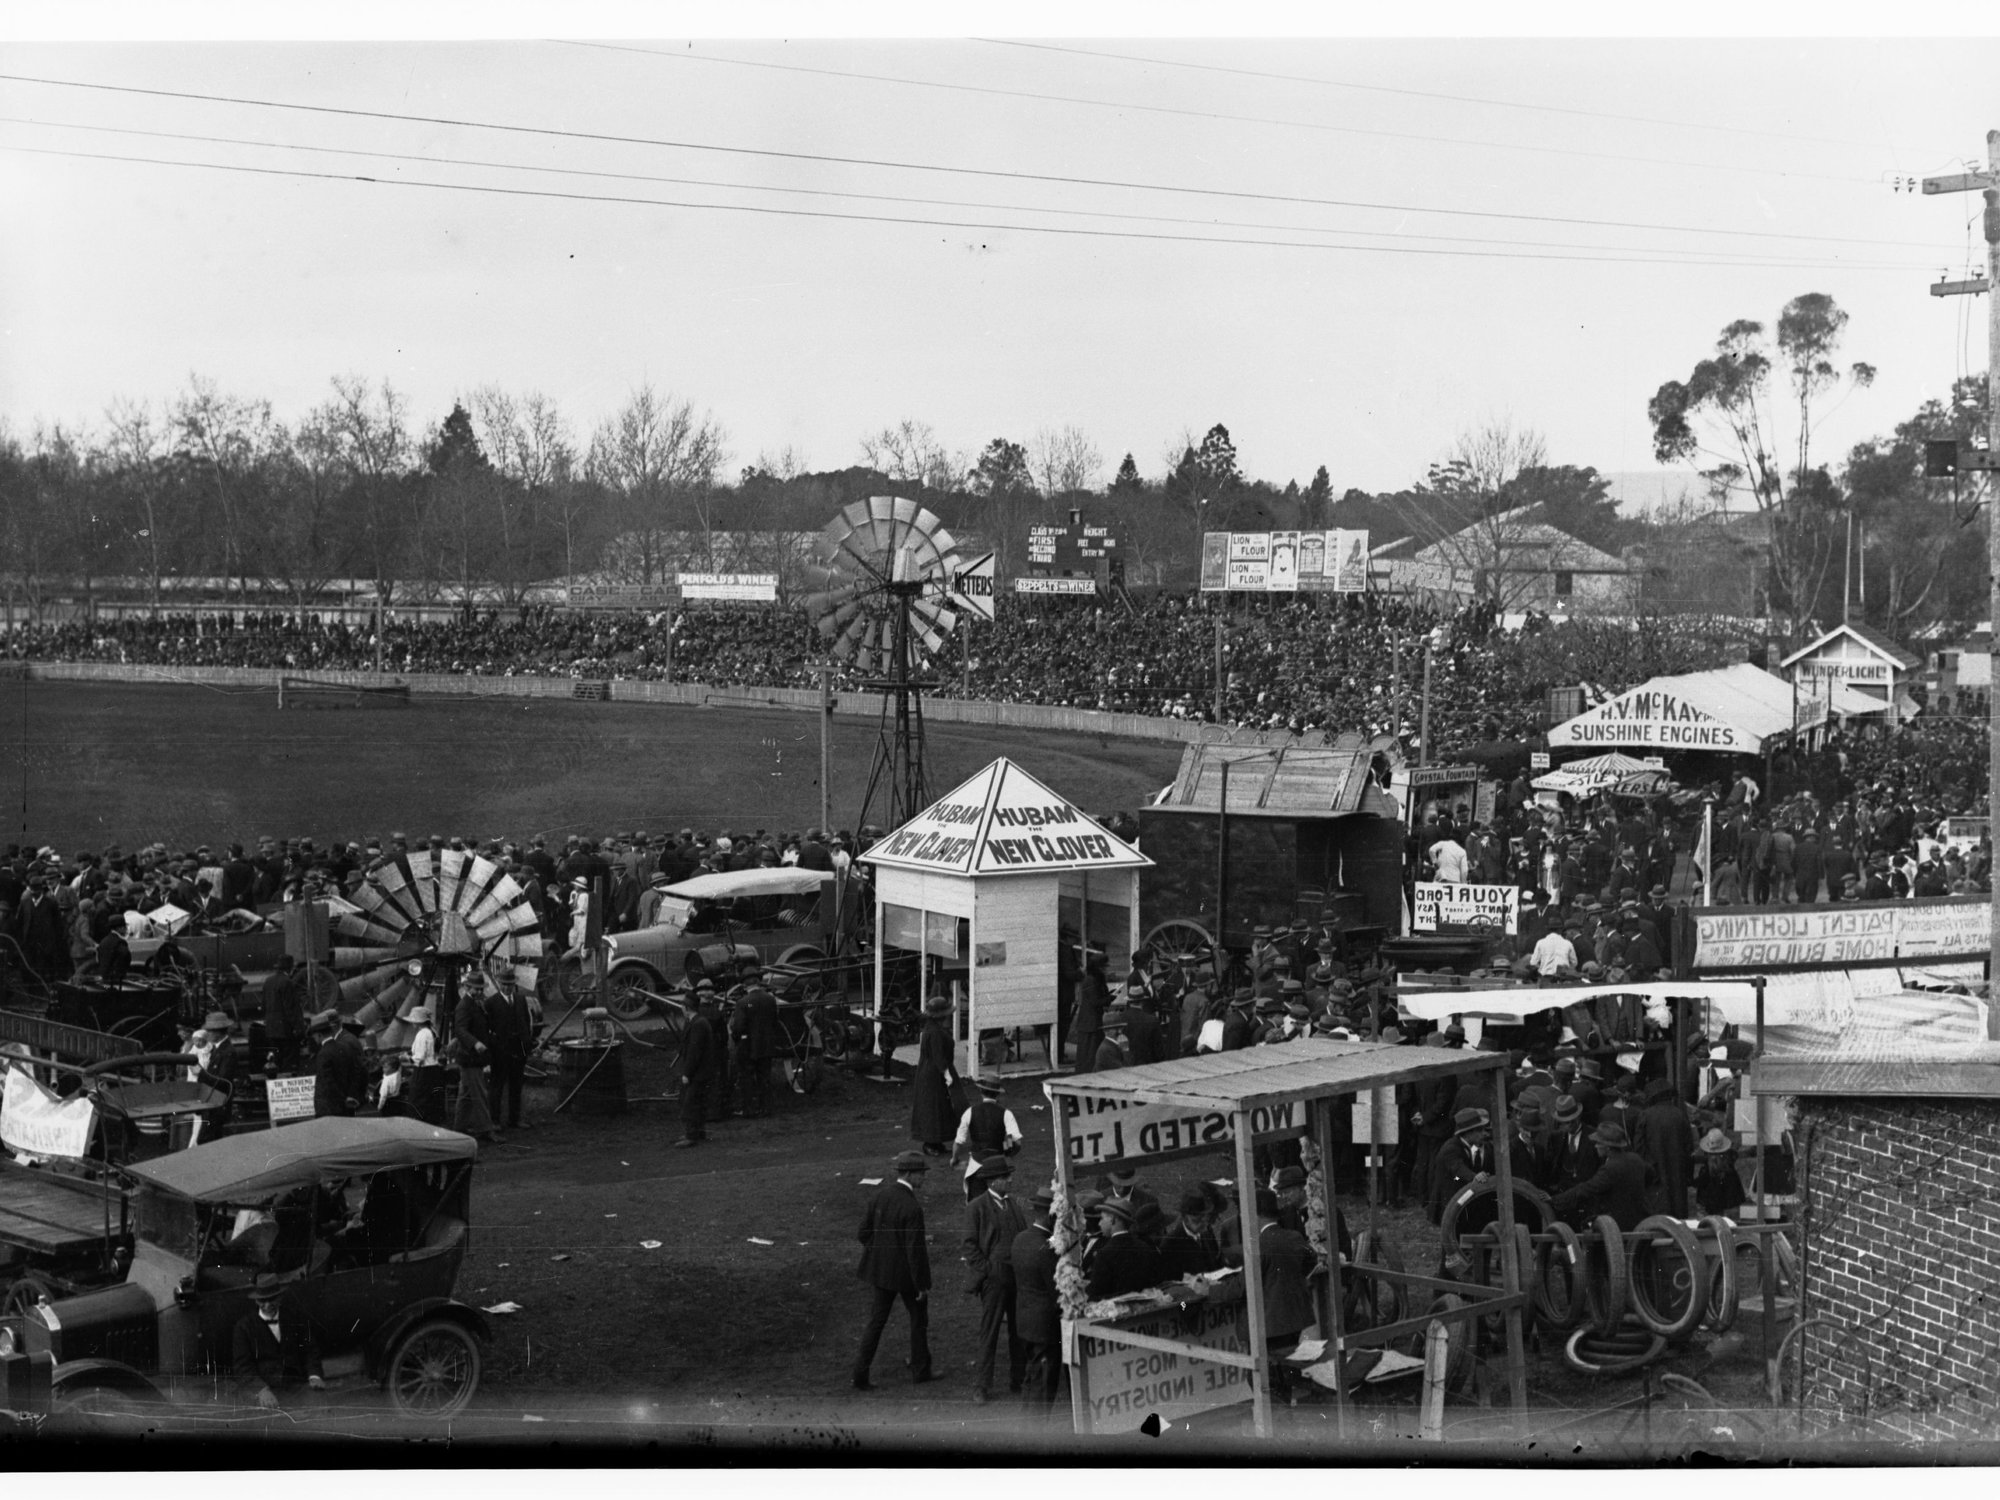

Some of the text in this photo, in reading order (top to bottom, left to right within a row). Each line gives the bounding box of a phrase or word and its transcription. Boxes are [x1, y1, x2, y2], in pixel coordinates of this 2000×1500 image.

[1033, 537, 1056, 545] FIRST
[1233, 536, 1250, 544] LION
[1241, 546, 1266, 555] FLOUR
[1231, 565, 1249, 573] LION
[954, 572, 993, 596] METTERS
[1068, 581, 1095, 592] WINES
[1239, 575, 1264, 584] FLOUR
[1801, 664, 1875, 679] WUNDERLICH
[1571, 724, 1739, 746] SUNSHINE ENGINES.
[1446, 766, 1475, 782] FOUNTAIN
[926, 803, 985, 825] HUBAM
[994, 804, 1078, 826] HUBAM
[883, 830, 975, 864] NEW CLOVER
[986, 834, 1115, 865] NEW CLOVER
